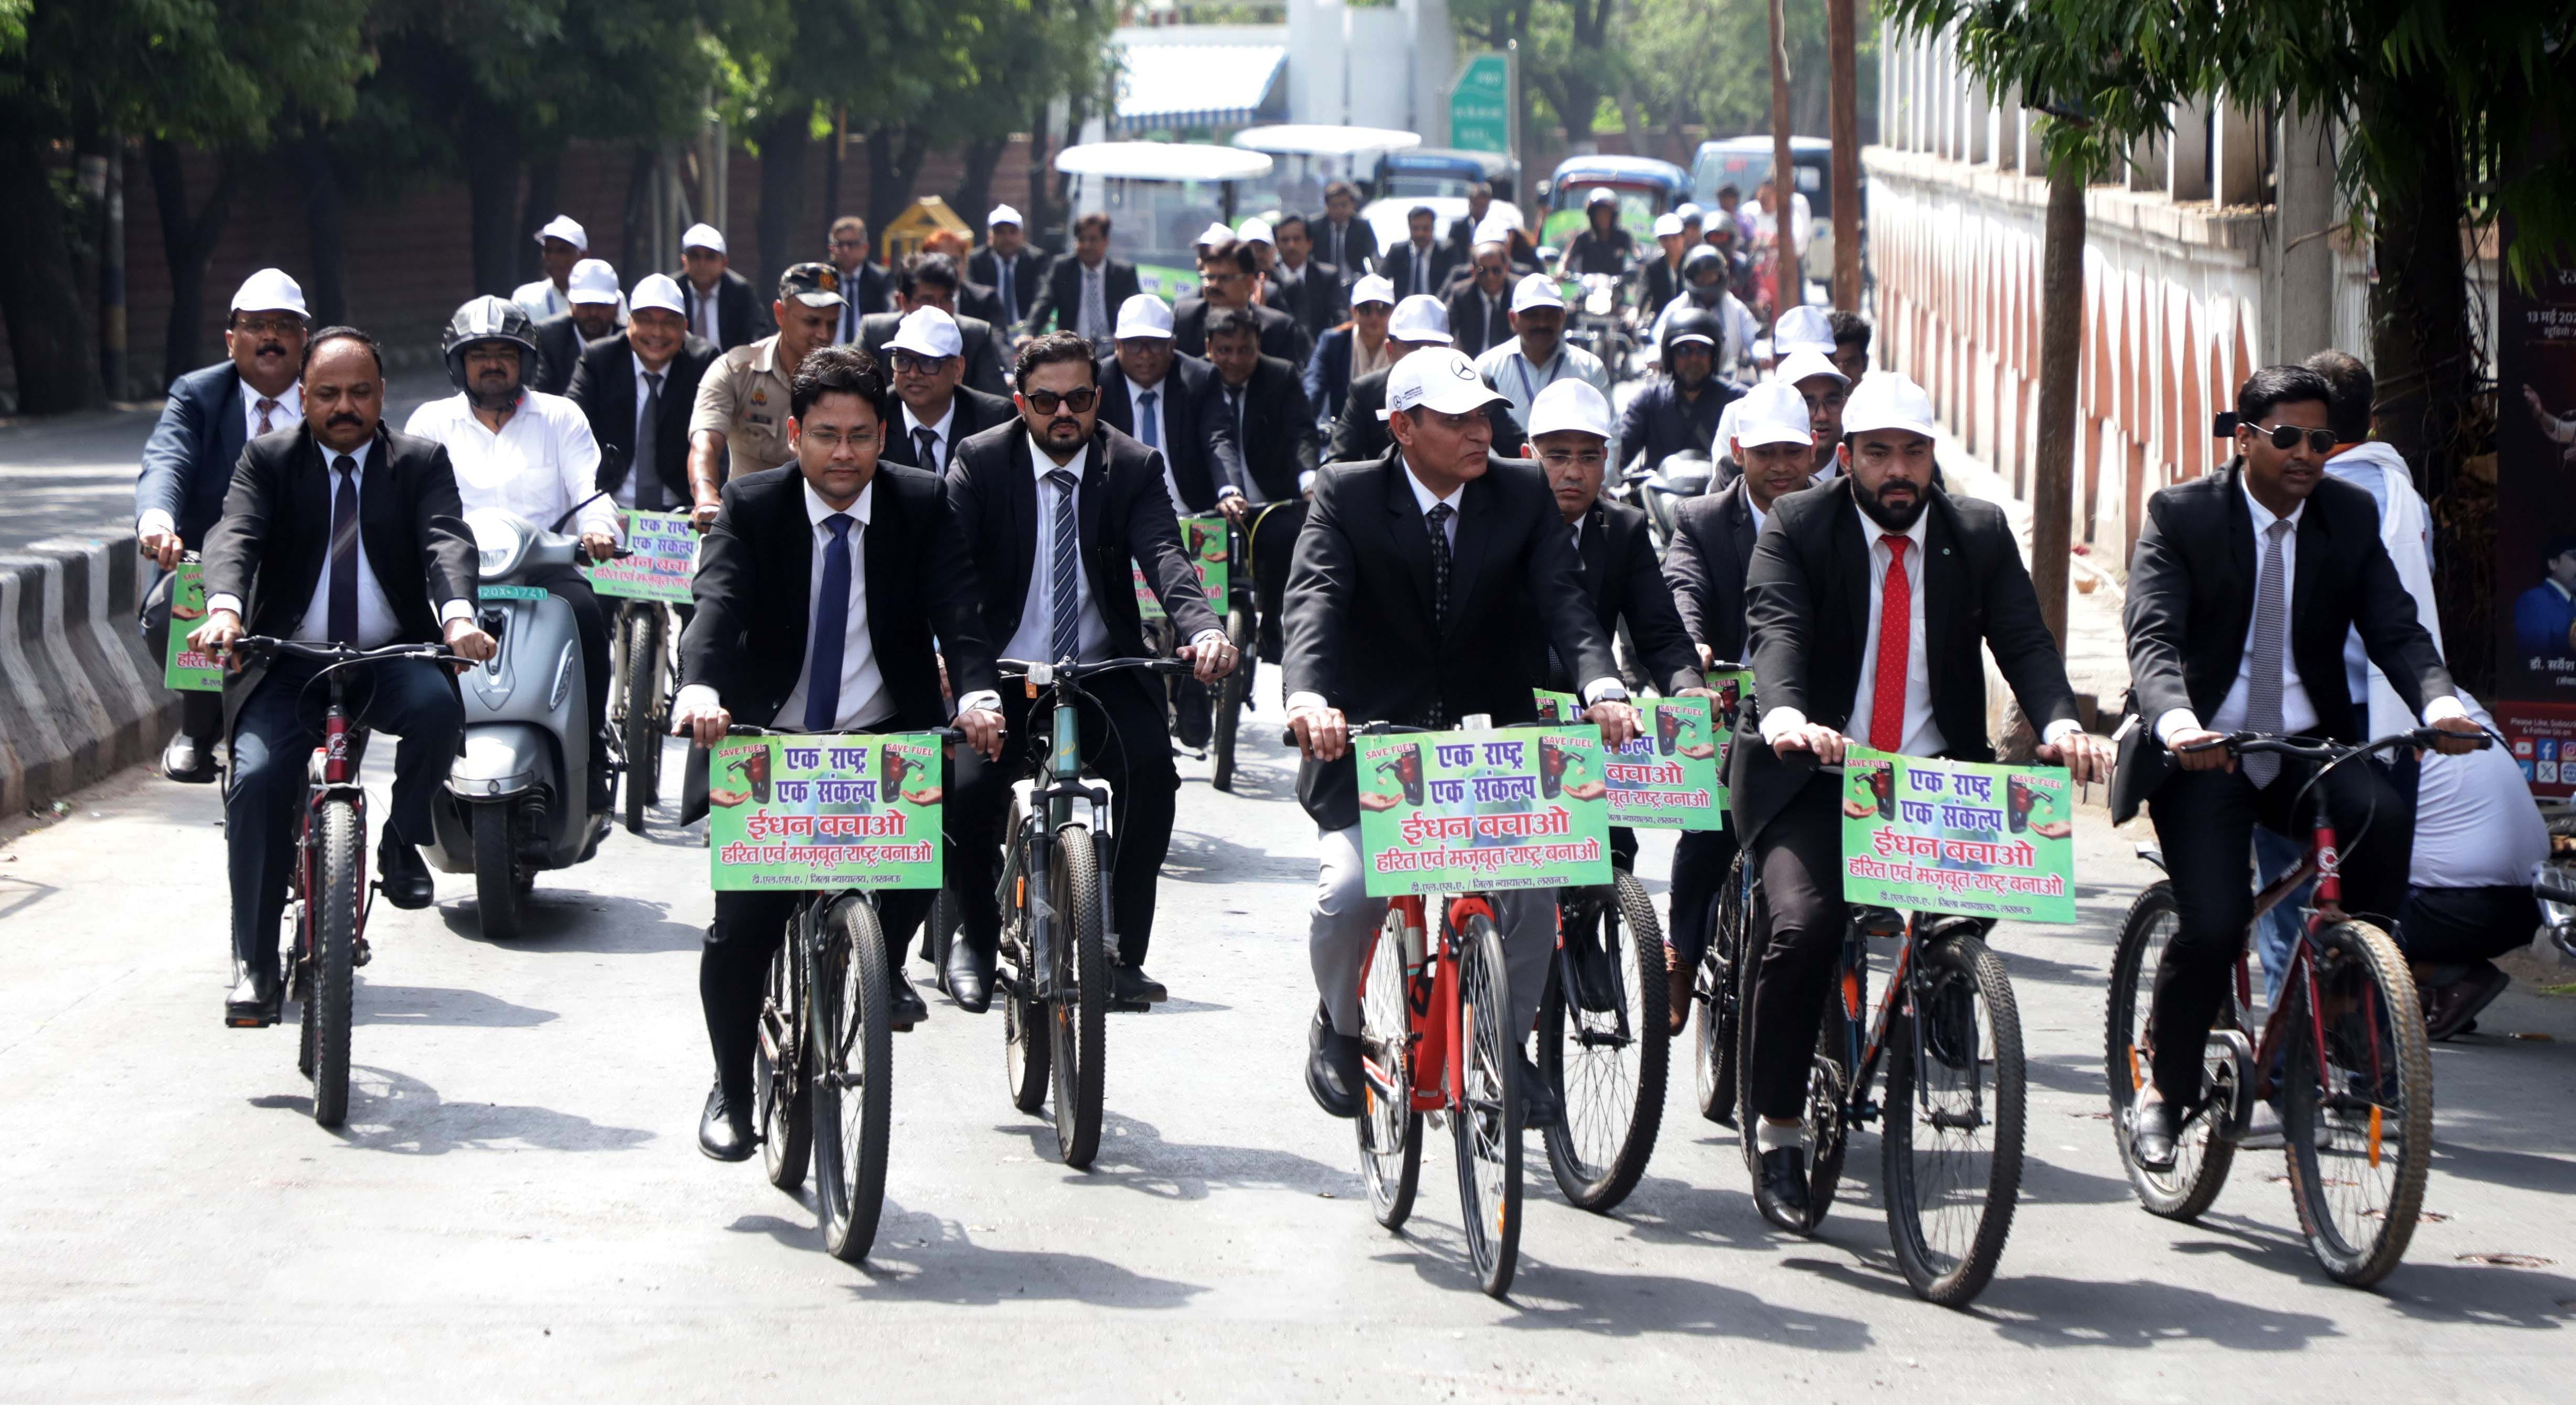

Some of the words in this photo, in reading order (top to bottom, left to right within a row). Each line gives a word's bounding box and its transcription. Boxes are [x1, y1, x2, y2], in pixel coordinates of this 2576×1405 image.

[640, 518, 661, 532] एक
[632, 536, 653, 549] एक
[1715, 678, 1735, 687] FUEL
[1660, 705, 1680, 713] SAVE
[1683, 707, 1703, 716] FUEL
[718, 748, 740, 758] SAVE
[743, 744, 766, 754] FUEL
[886, 743, 908, 753] SAVE
[911, 746, 933, 756] FUEL
[1366, 748, 1388, 759] SAVE
[1391, 743, 1415, 753] FUEL
[1543, 736, 1566, 745] SAVE
[1569, 738, 1592, 748] FUEL
[785, 748, 821, 770] एक
[828, 748, 867, 774] राष्ट्र
[1435, 744, 1475, 768] एक
[1482, 742, 1523, 770] राष्ट्र
[1847, 759, 1866, 768] SAVE
[1869, 760, 1890, 769] FUEL
[1605, 761, 1683, 784] बचाओ
[2011, 774, 2035, 784] SAVE
[2038, 778, 2062, 789] FUEL
[775, 781, 810, 803] एक
[816, 773, 877, 803] संकल्प
[1429, 780, 1465, 804] एक
[1472, 770, 1537, 802] संकल्प
[1908, 769, 1945, 793] एक
[1952, 774, 1992, 803] राष्ट्र
[1633, 791, 1661, 808] राष्ट्र
[1663, 790, 1709, 807] बनाओ
[819, 809, 907, 836] बचाओ
[1477, 806, 1570, 837] बचाओ
[1900, 800, 1934, 824] एक
[1941, 799, 2003, 832] संकल्प
[721, 841, 759, 862] हरित
[763, 840, 787, 863] एवं
[789, 846, 843, 868] मज़बूत
[846, 846, 879, 865] राष्ट्र
[881, 840, 932, 861] बनाओ
[1376, 847, 1417, 871] हरित
[1420, 844, 1445, 870] एवं
[1448, 848, 1505, 872] मज़बूत
[1508, 846, 1542, 867] राष्ट्र
[1545, 838, 1600, 861] बनाओ
[1945, 840, 2034, 867] बचाओ
[1849, 855, 1886, 878] हरित
[1890, 860, 1913, 881] एवं
[1916, 868, 1971, 894] मज़बूत
[1974, 873, 2006, 894] राष्ट्र
[2010, 874, 2063, 895] बनाओ
